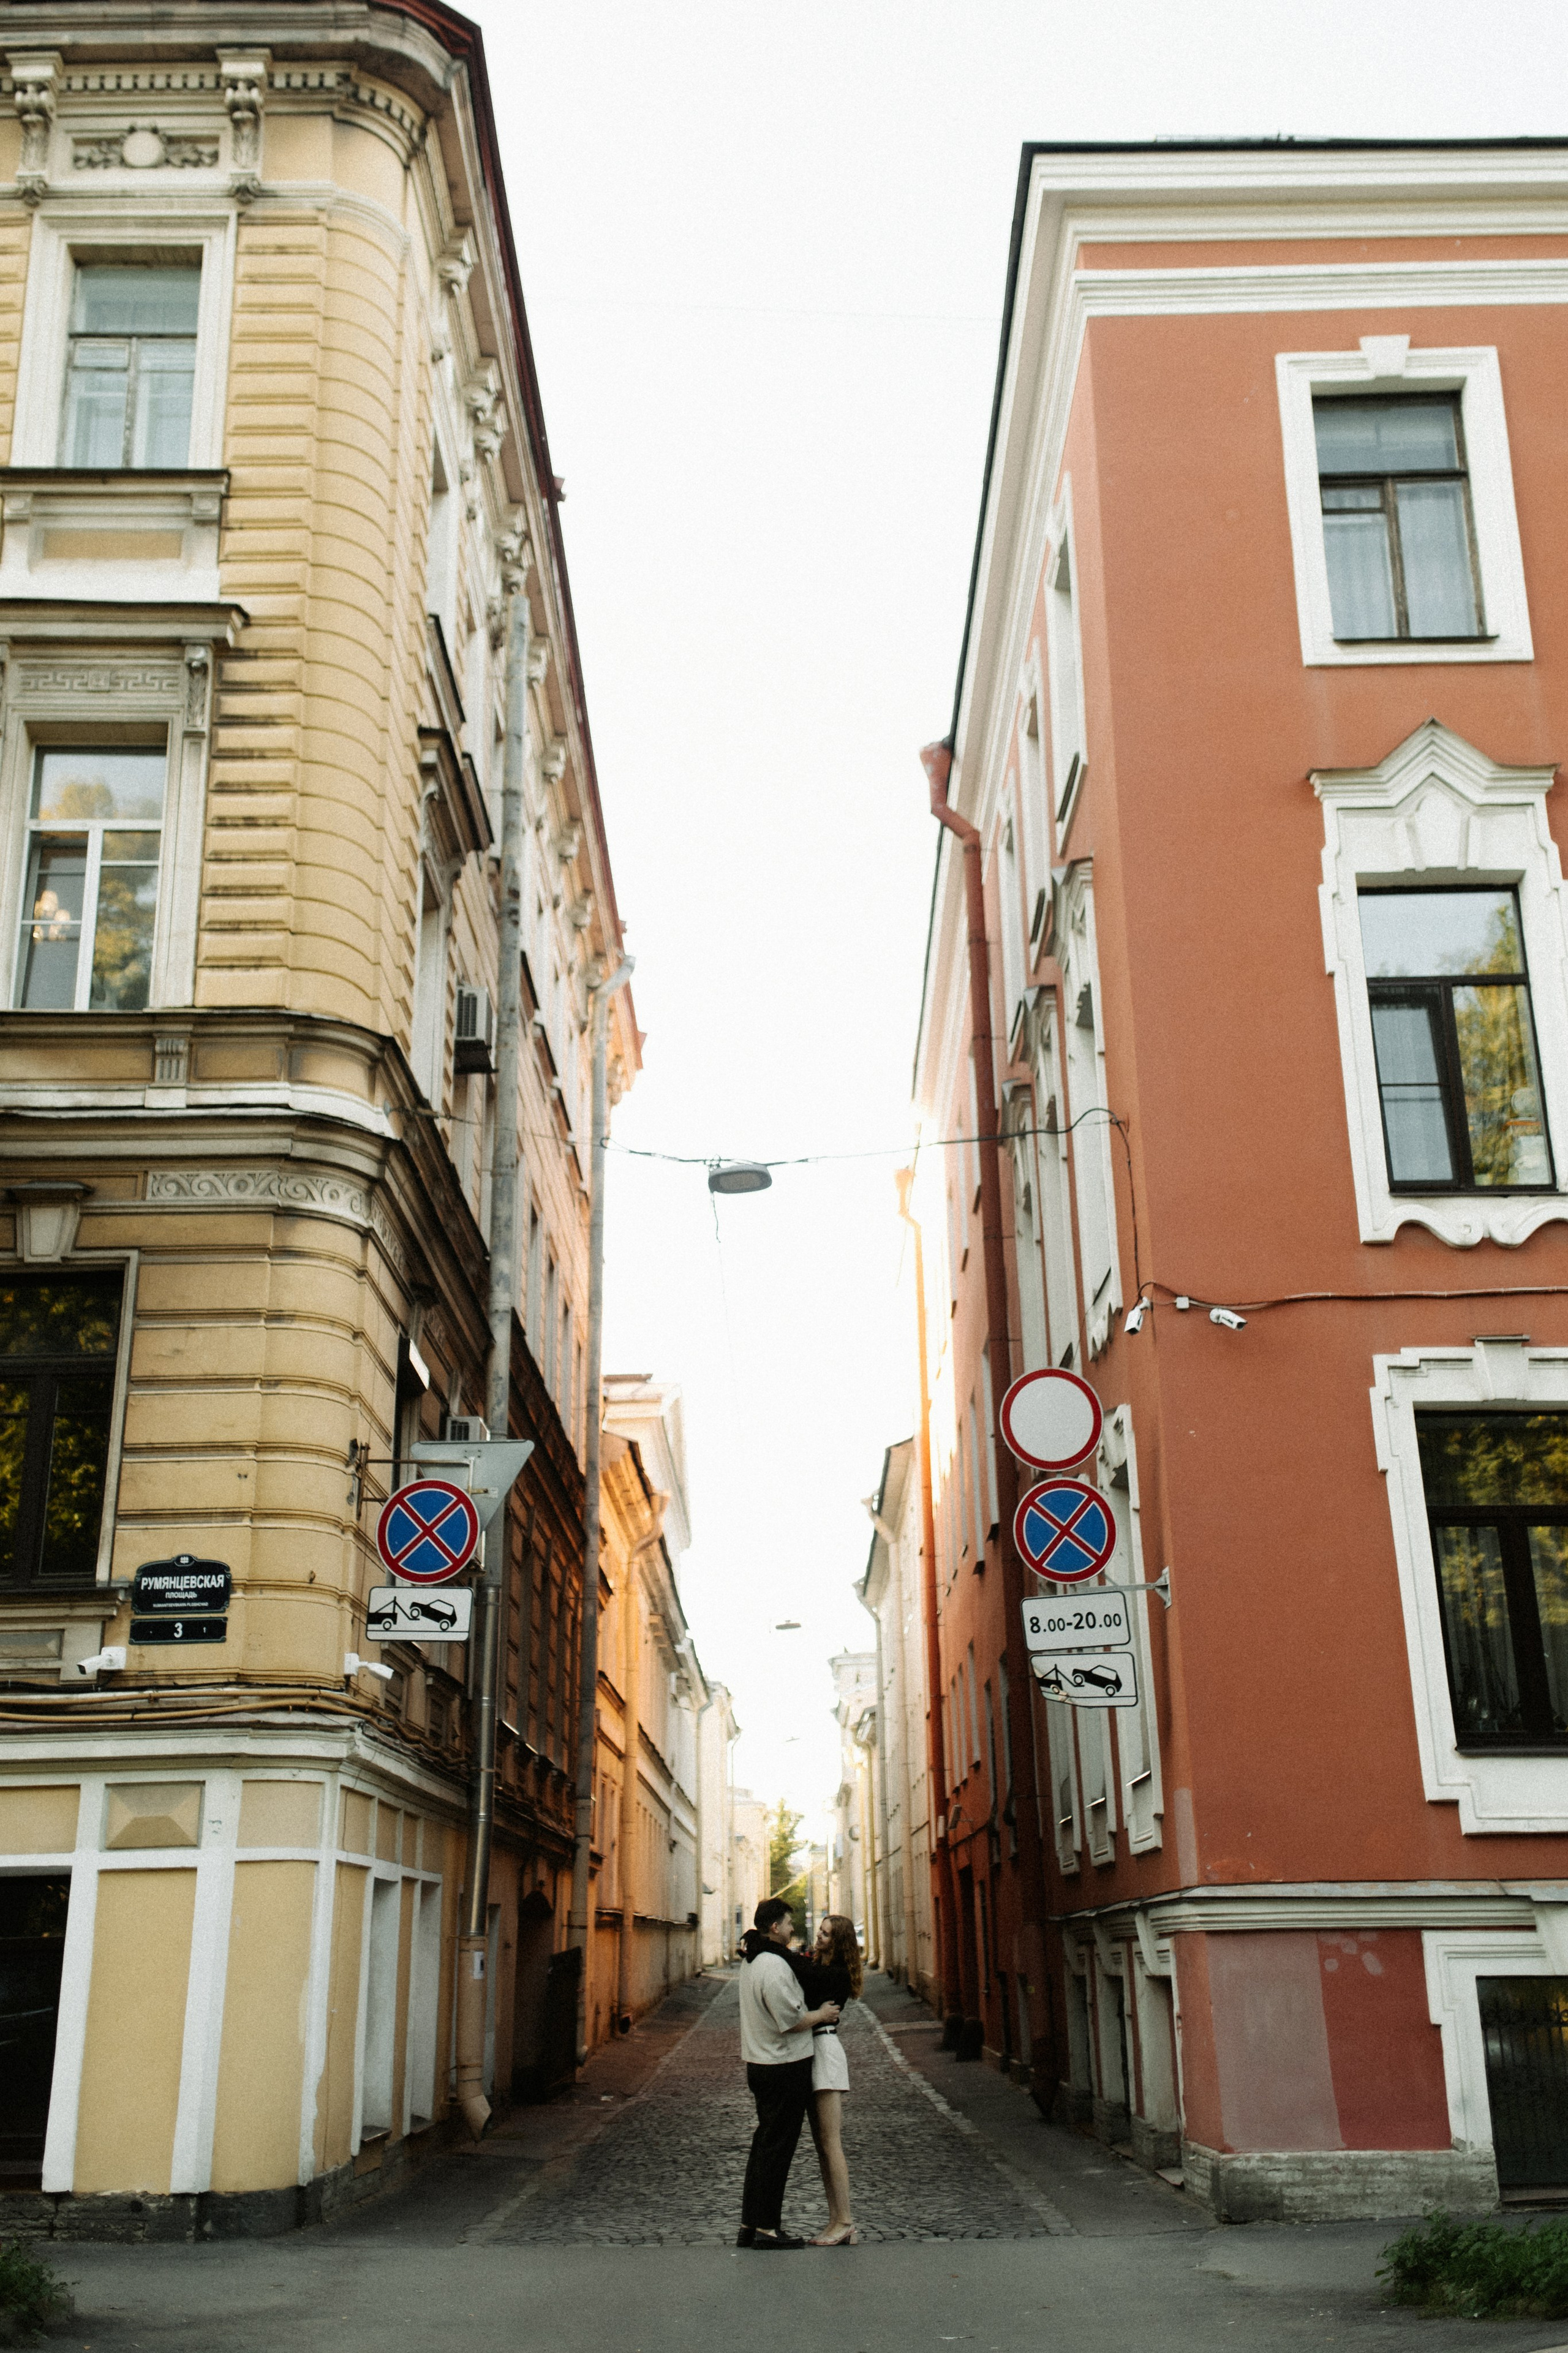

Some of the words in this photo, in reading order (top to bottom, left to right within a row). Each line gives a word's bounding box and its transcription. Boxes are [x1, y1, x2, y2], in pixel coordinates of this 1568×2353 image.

[141, 1574, 224, 1590] РУМЯНЦЕВСКАЯ
[174, 1622, 183, 1638] 3
[1030, 1612, 1121, 1634] 8.00-20.00
